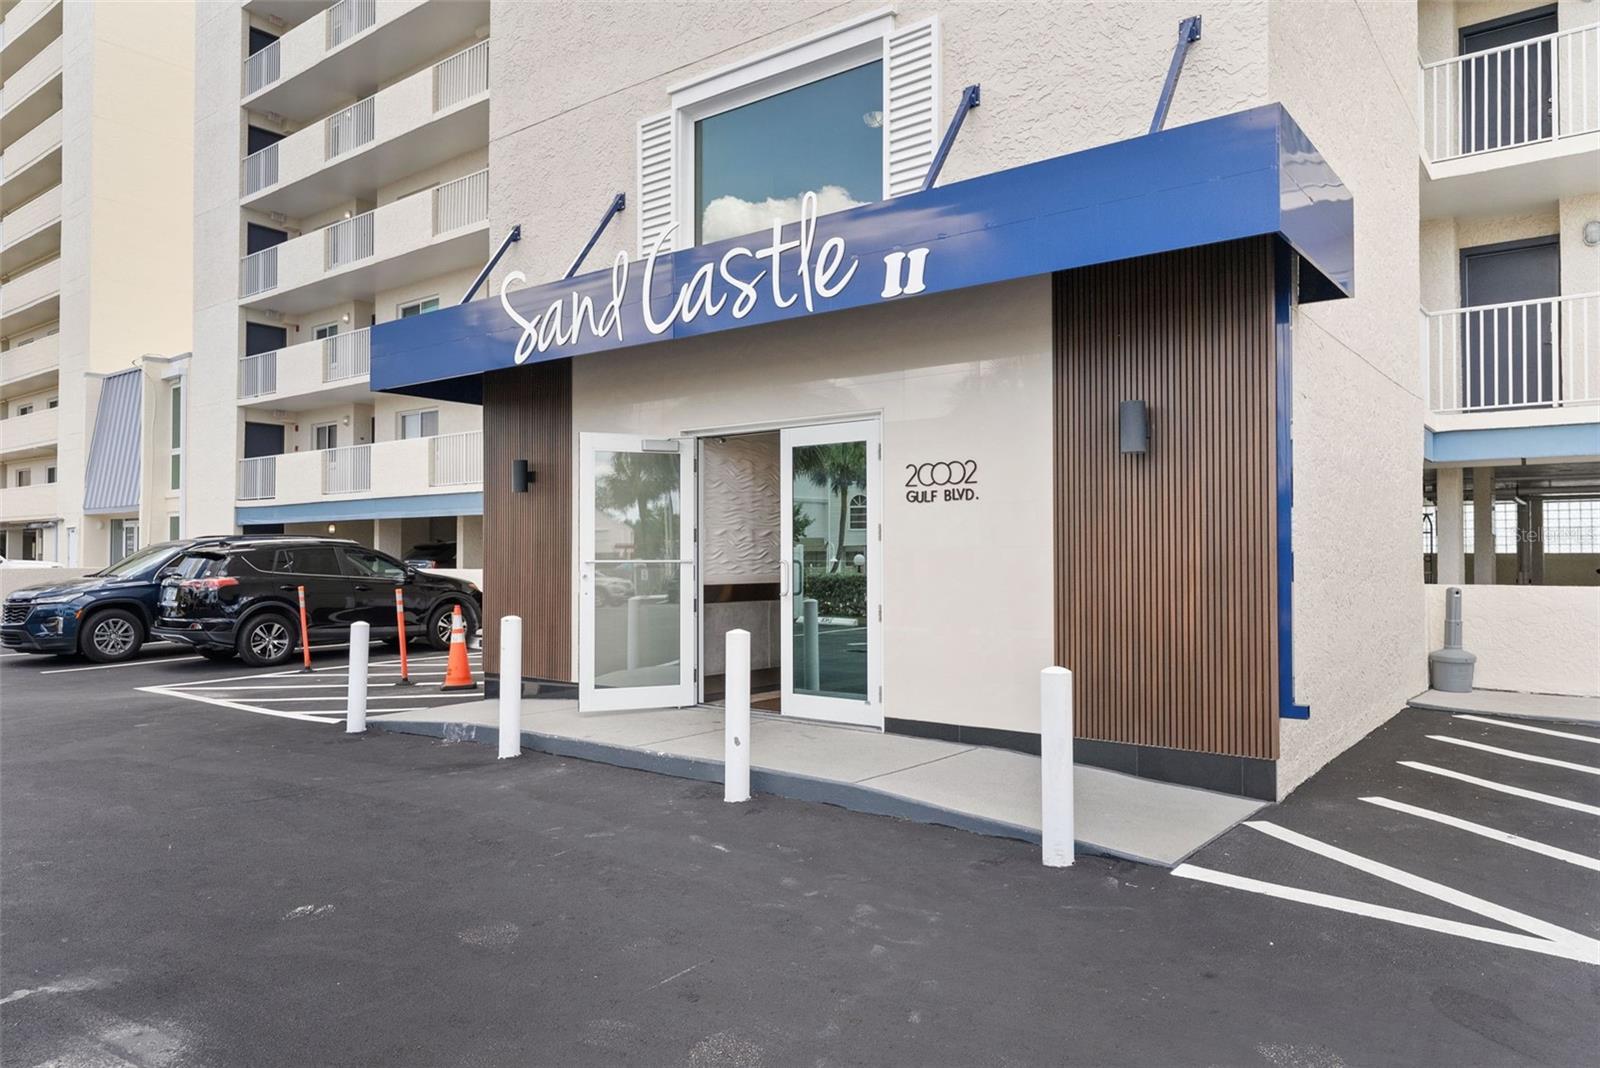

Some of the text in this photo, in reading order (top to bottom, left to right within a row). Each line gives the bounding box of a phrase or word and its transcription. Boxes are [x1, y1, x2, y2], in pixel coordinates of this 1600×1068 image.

[500, 191, 930, 365] Sand Castle II
[905, 459, 978, 487] 20002
[906, 488, 979, 503] GULF BLVD.
